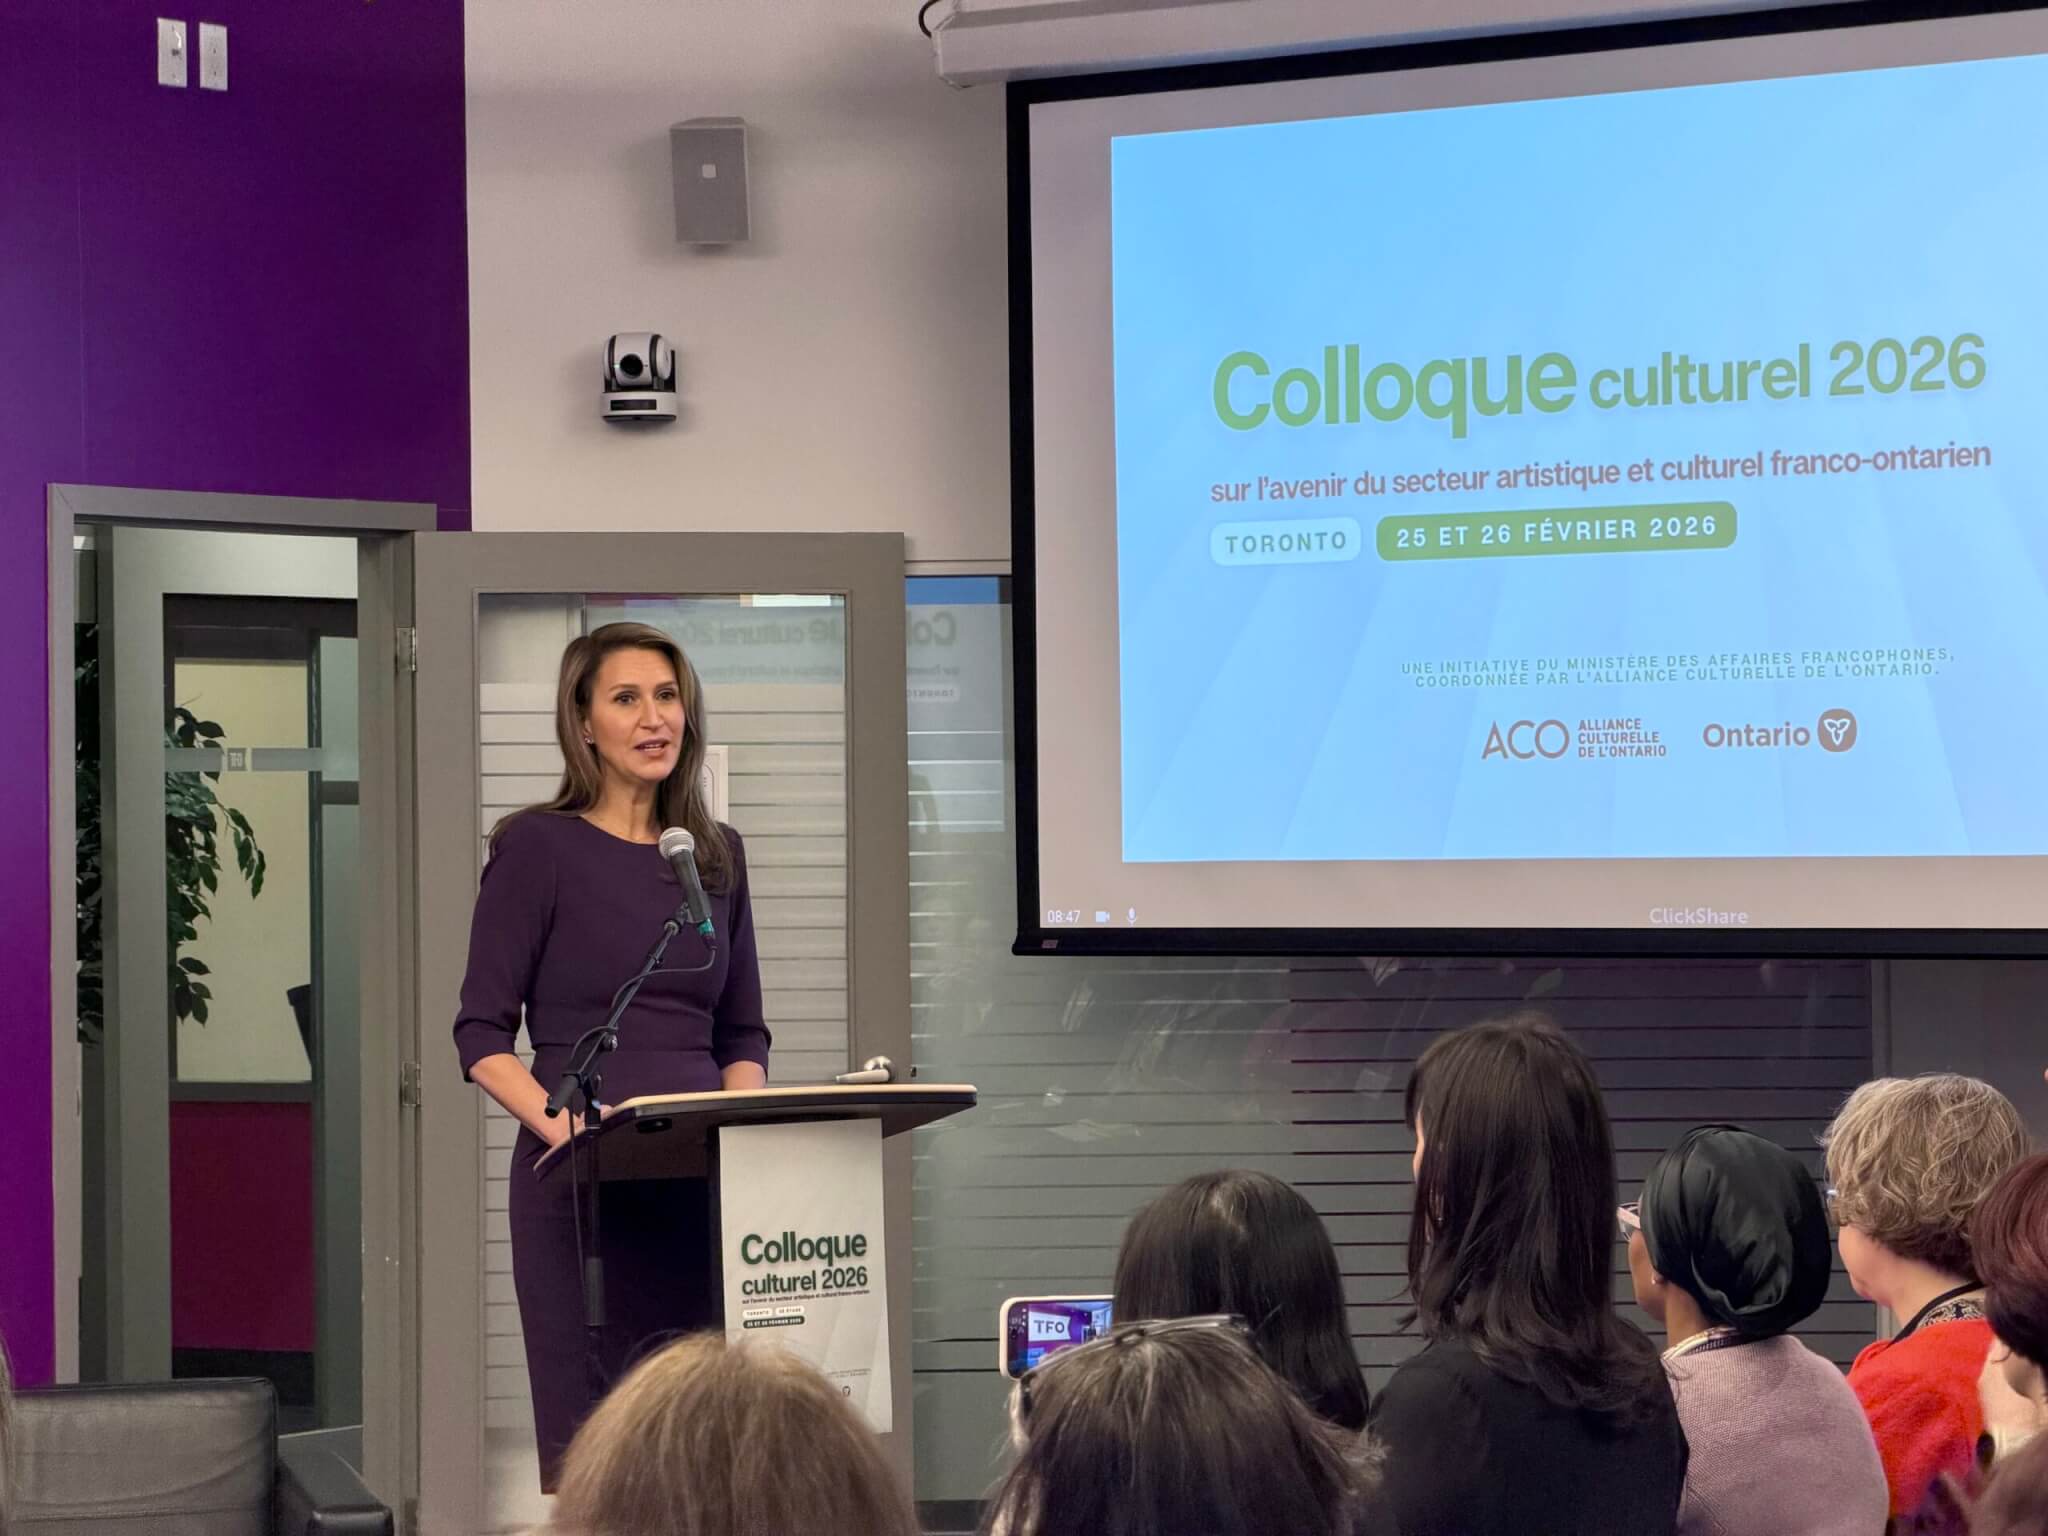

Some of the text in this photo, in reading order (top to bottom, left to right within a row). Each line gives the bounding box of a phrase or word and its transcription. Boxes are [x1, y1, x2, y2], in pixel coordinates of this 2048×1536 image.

[1213, 333, 1987, 439] Colloque culturel 2026
[1211, 441, 1992, 502] sur l'avenir du secteur artistique et culturel franco-ontarien
[1225, 531, 1347, 554] TORONTO
[1397, 515, 1717, 548] 25 ET 26 FÉVRIER 2026
[1402, 648, 1955, 675] UNE INITIATIVE DU MINISTÈRE DES AFFAIRES FRANCOPHONES,
[1415, 662, 1940, 688] COORDONNÉE PAR L'ALLIANCE CULTURELLE DE L'ONTARIO.
[1578, 718, 1642, 732] ALLIANCE
[1578, 731, 1660, 745] CULTURELLE
[1702, 721, 1812, 748] Ontario
[1481, 719, 1570, 760] ACO
[1578, 744, 1667, 758] DE L'ONTARIO
[1047, 910, 1081, 923] 08:47
[1649, 907, 1749, 925] ClickShare
[741, 1231, 867, 1267] Colloque
[742, 1266, 868, 1295] culturel 2026
[1033, 1320, 1065, 1334] TFO
